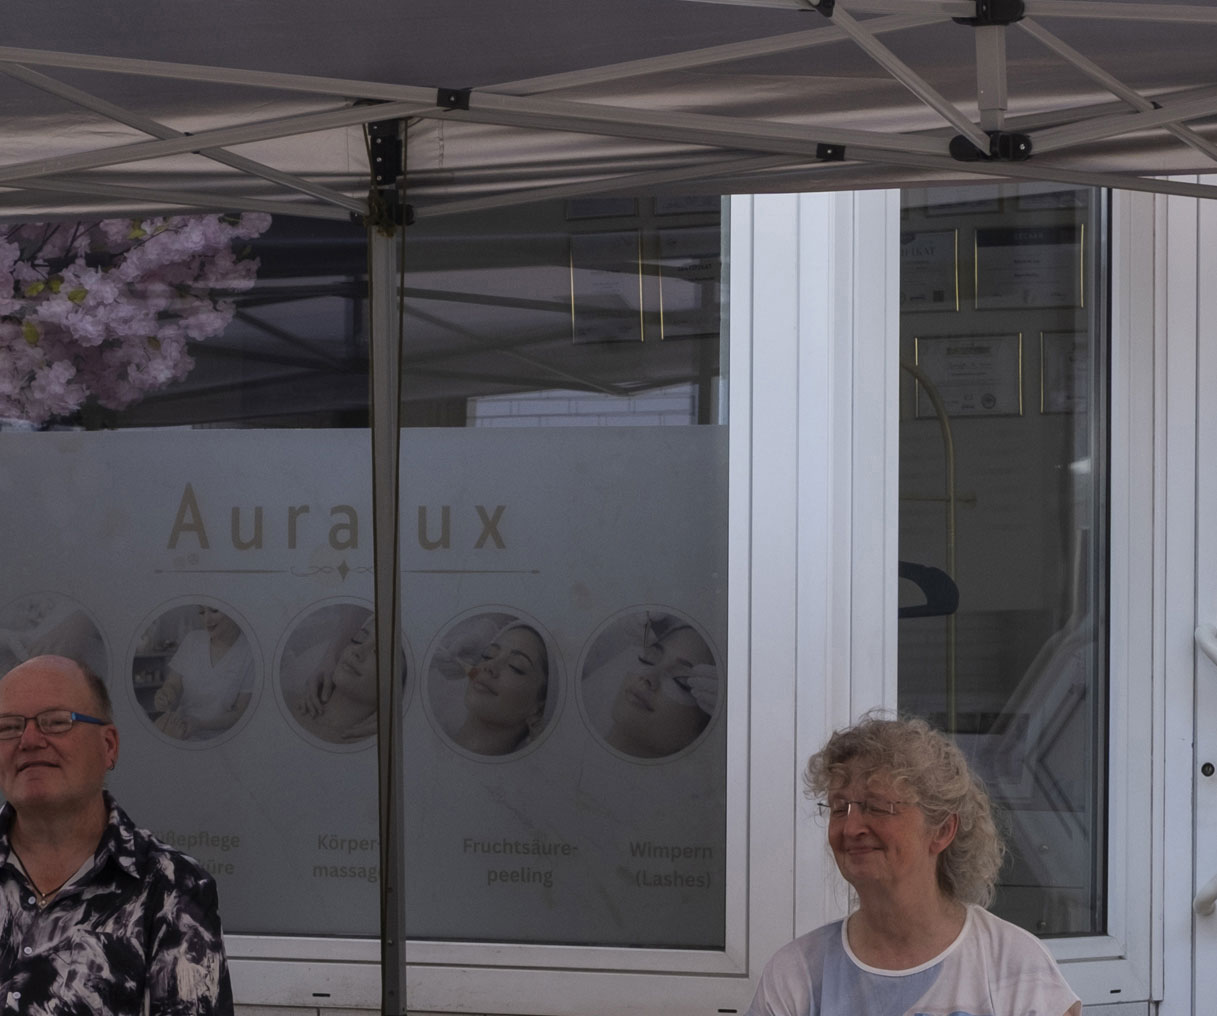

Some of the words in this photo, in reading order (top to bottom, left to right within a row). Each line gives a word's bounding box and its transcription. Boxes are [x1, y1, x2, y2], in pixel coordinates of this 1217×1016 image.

[167, 481, 507, 551] Auraux
[463, 837, 580, 857] Fruchtsäure-
[629, 840, 714, 863] Wimpern
[312, 863, 381, 883] massag
[487, 866, 554, 889] peeling
[635, 868, 713, 889] (Lashes)
